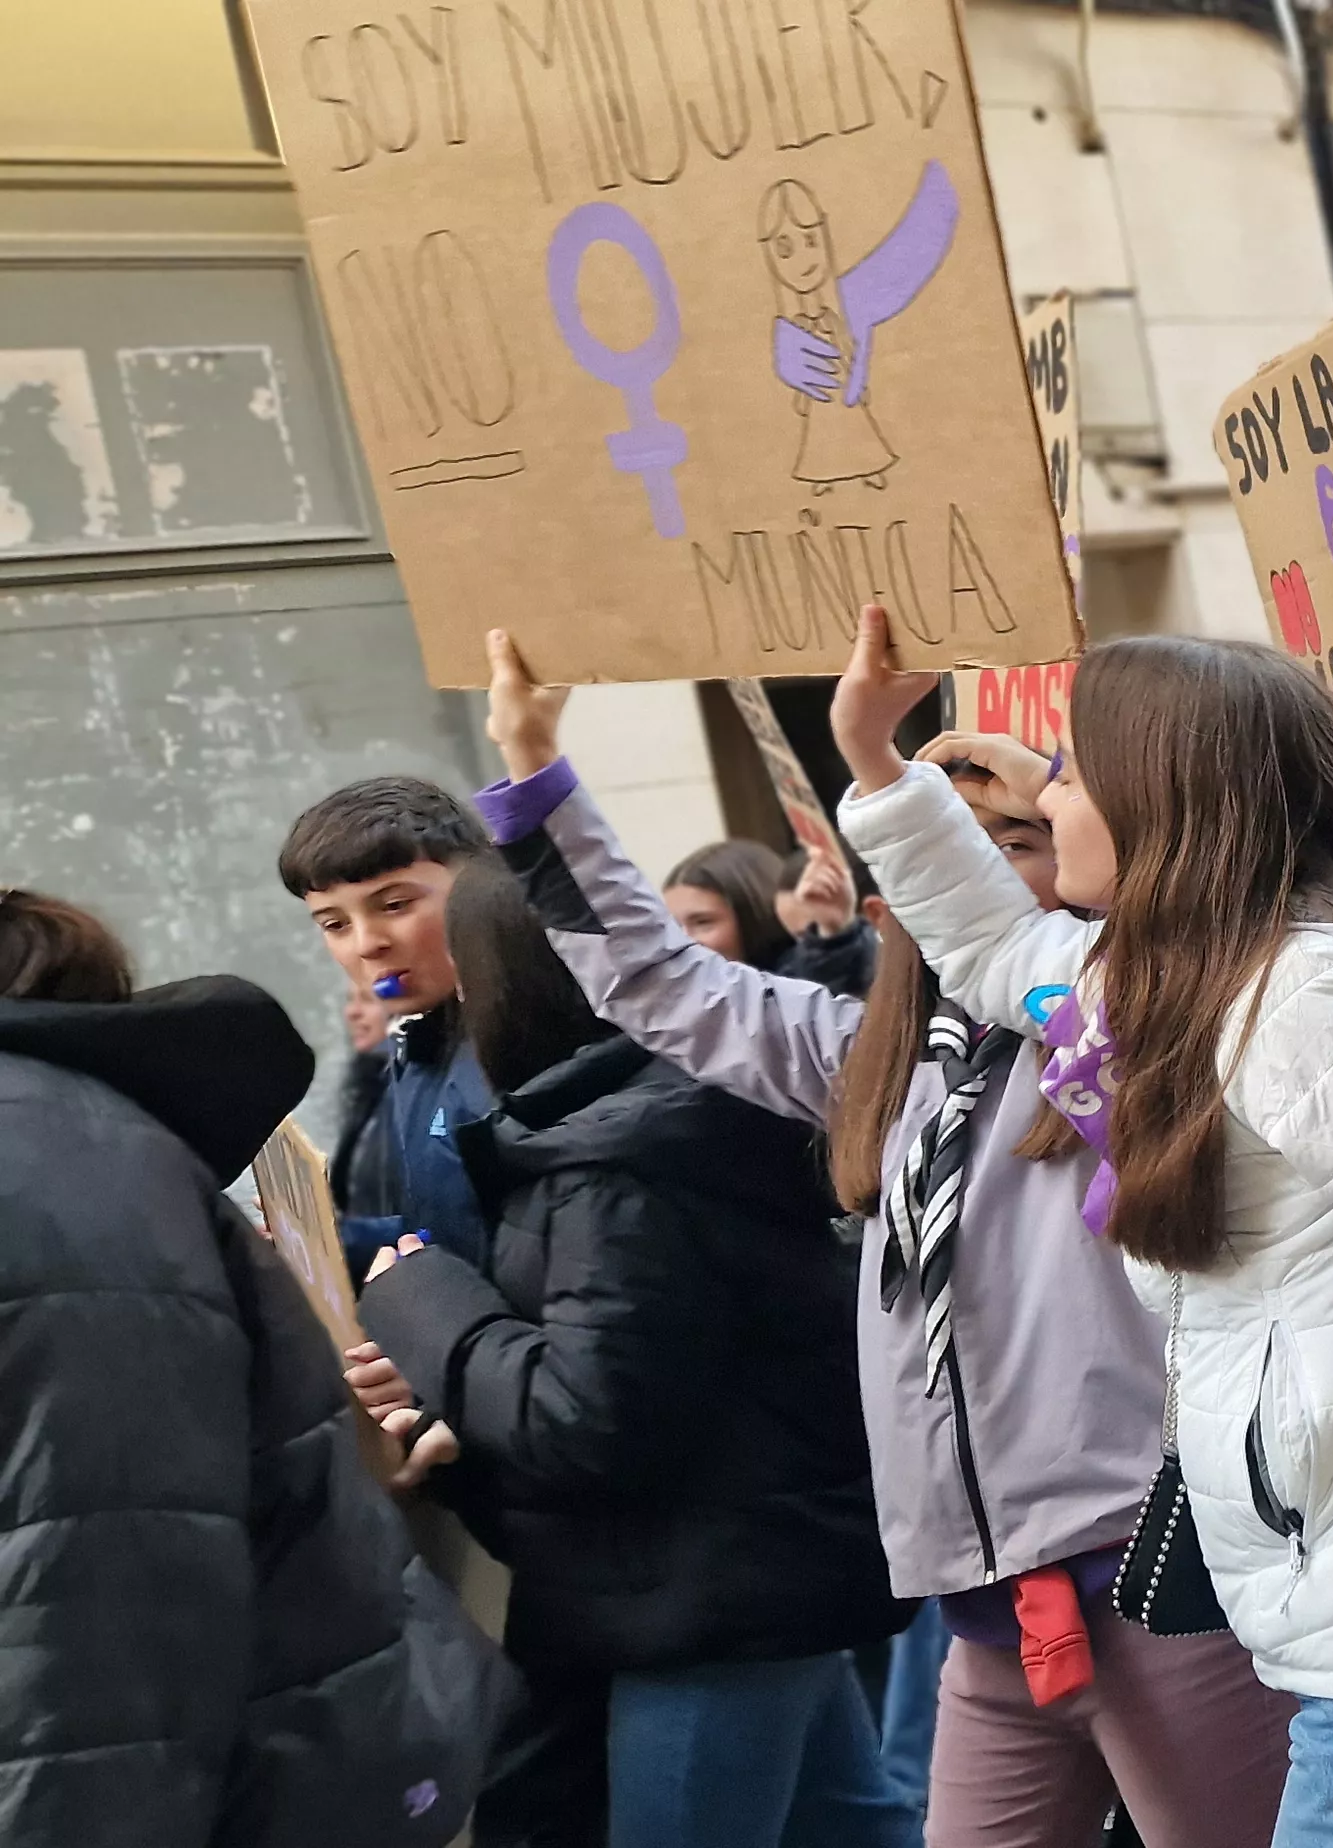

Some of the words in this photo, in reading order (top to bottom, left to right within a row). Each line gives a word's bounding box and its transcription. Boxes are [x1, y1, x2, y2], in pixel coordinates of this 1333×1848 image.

[301, 4, 468, 172] SOY
[336, 228, 517, 442] NO
[1224, 386, 1290, 496] SOY
